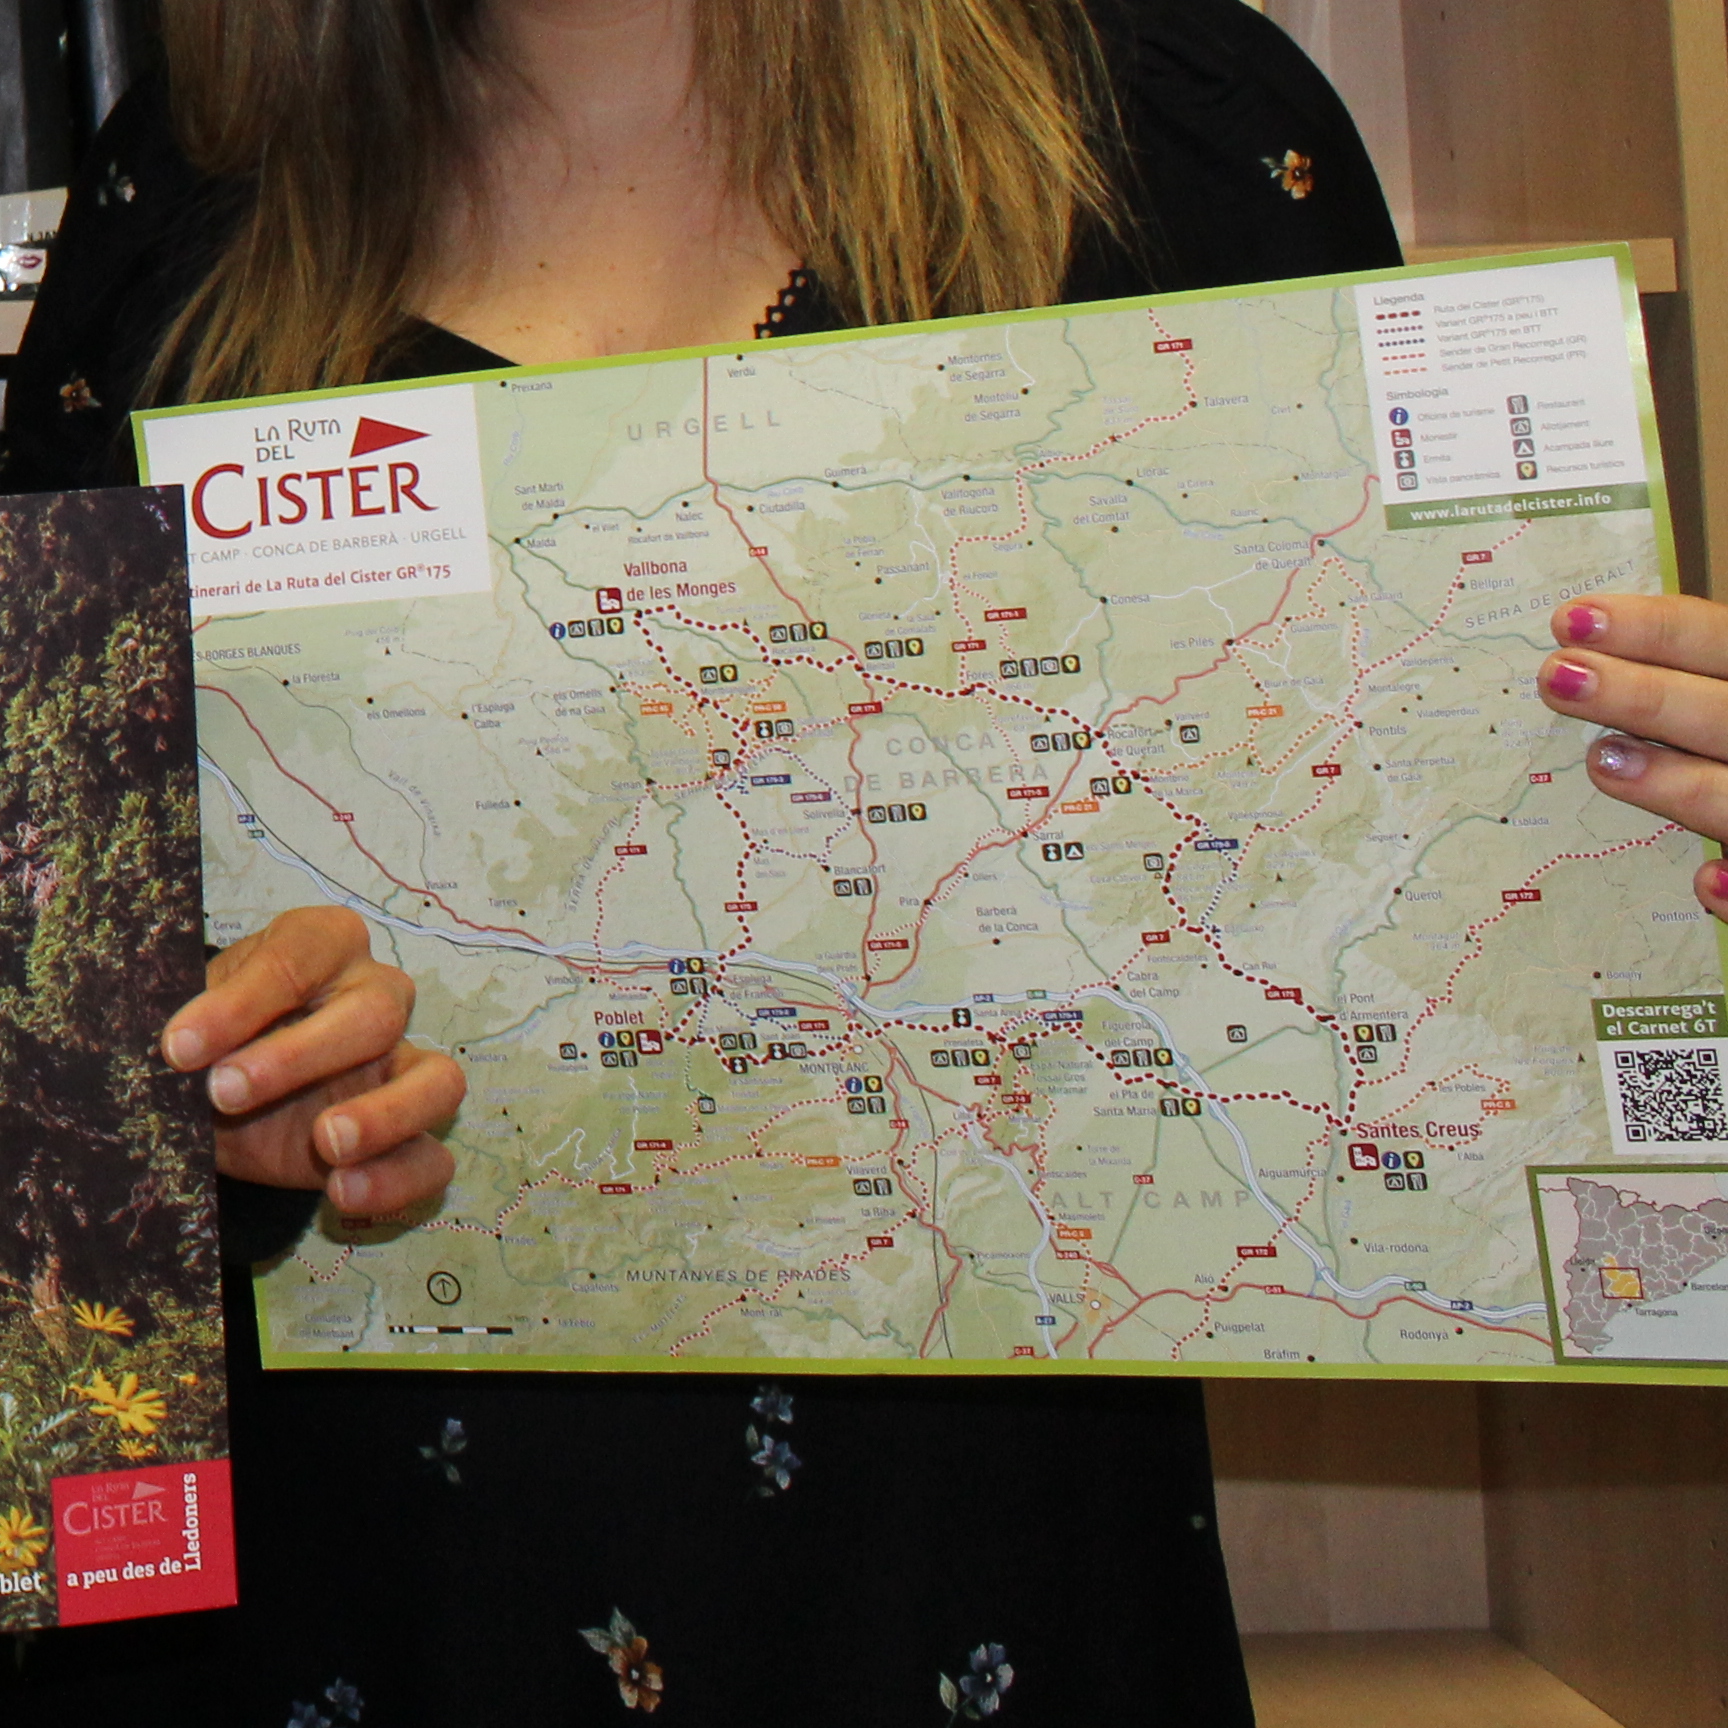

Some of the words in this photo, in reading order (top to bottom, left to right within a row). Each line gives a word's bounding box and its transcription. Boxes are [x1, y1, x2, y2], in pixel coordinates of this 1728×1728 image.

[1373, 292, 1424, 306] Llegenda
[1204, 393, 1249, 406] Talavera
[1386, 386, 1448, 401] Simbologia
[256, 444, 295, 463] DEL
[192, 461, 439, 539] CISTER
[1411, 491, 1612, 521] www.larutadelcister.info
[199, 547, 240, 563] CAMP
[253, 540, 302, 558] CONCA
[309, 539, 328, 554] DE
[332, 532, 398, 551] BARBERÀ
[411, 528, 467, 545] URGELL
[1233, 542, 1264, 555] Santa
[1267, 539, 1308, 552] Coloma
[623, 560, 687, 576] Vallbona
[1255, 558, 1268, 570] de
[244, 575, 261, 593] de
[266, 574, 282, 590] La
[287, 571, 320, 589] Ruta
[325, 569, 344, 585] del
[350, 565, 391, 584] Cister
[1470, 576, 1515, 591] Bellprat
[627, 585, 642, 601] de
[649, 583, 671, 600] les
[677, 580, 738, 602] Monges
[1110, 593, 1150, 605] Conesa
[1465, 605, 1523, 628] SERRA
[1530, 594, 1551, 608] DE
[1558, 560, 1635, 601] QUERALT
[1369, 724, 1406, 737] Pontils
[887, 735, 996, 756] CONCA
[843, 773, 881, 793] DE
[887, 760, 1049, 791] BARBERÀ
[1405, 890, 1441, 901] Querol
[1652, 910, 1699, 923] Pontons
[594, 1010, 644, 1026] Poblet
[1602, 1000, 1716, 1020] Descarrega't
[1606, 1022, 1623, 1035] el
[1628, 1020, 1689, 1035] Carnet
[1695, 1019, 1716, 1034] 6T
[799, 1062, 868, 1074] MONTBLANC
[1357, 1123, 1420, 1139] Santes
[1425, 1122, 1479, 1138] Creus
[1051, 1192, 1113, 1209] ALT
[1145, 1191, 1250, 1209] CAMP
[1364, 1242, 1428, 1254] Vila-rodona
[627, 1270, 738, 1281] MUNTANYES
[745, 1270, 770, 1281] DE
[1048, 1292, 1084, 1304] VALLS
[1214, 1321, 1264, 1335] Puigpelat
[63, 1501, 168, 1535] CISTER
[183, 1473, 202, 1571] Lledoners
[67, 1573, 79, 1586] a
[83, 1568, 118, 1589] peu
[123, 1563, 155, 1581] des
[159, 1558, 181, 1576] de
